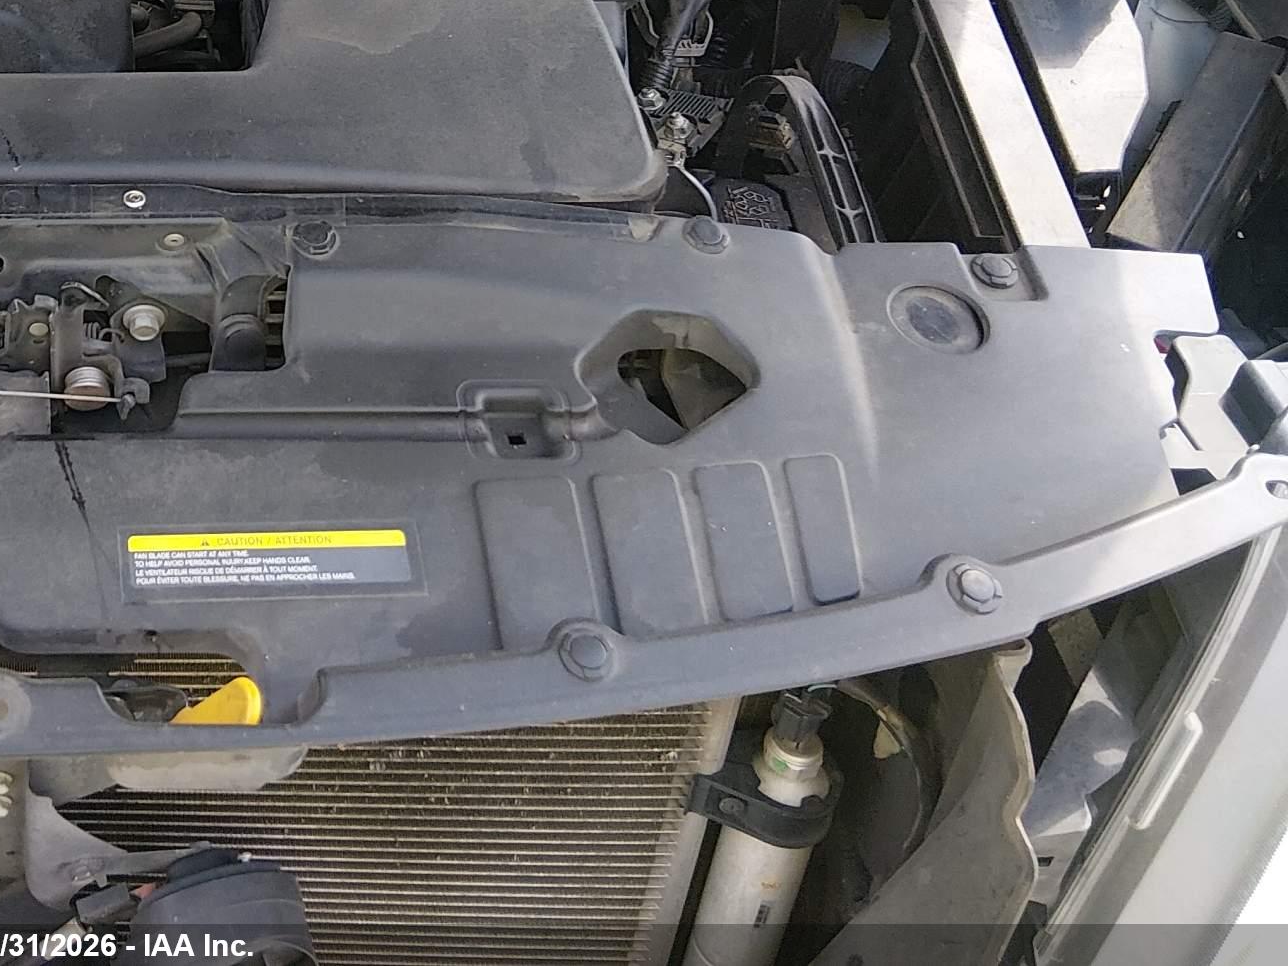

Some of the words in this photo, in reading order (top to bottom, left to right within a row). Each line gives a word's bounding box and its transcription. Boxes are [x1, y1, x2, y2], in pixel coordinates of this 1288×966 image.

[216, 537, 263, 546] CAUTION
[275, 535, 332, 545] ATTENTION
[217, 550, 231, 558] ANY
[164, 559, 184, 567] AVOID
[185, 558, 220, 566] PERSONAL
[263, 557, 286, 565] HANDS
[136, 569, 144, 577] LE
[144, 568, 188, 576] VENTILATEUR
[225, 565, 262, 574] DÉMARRER
[269, 565, 287, 573] TOUT
[136, 577, 156, 585] POUR
[157, 576, 179, 584] ÉVITER
[180, 576, 202, 584] TOUTE
[276, 573, 318, 581] APPROCHER
